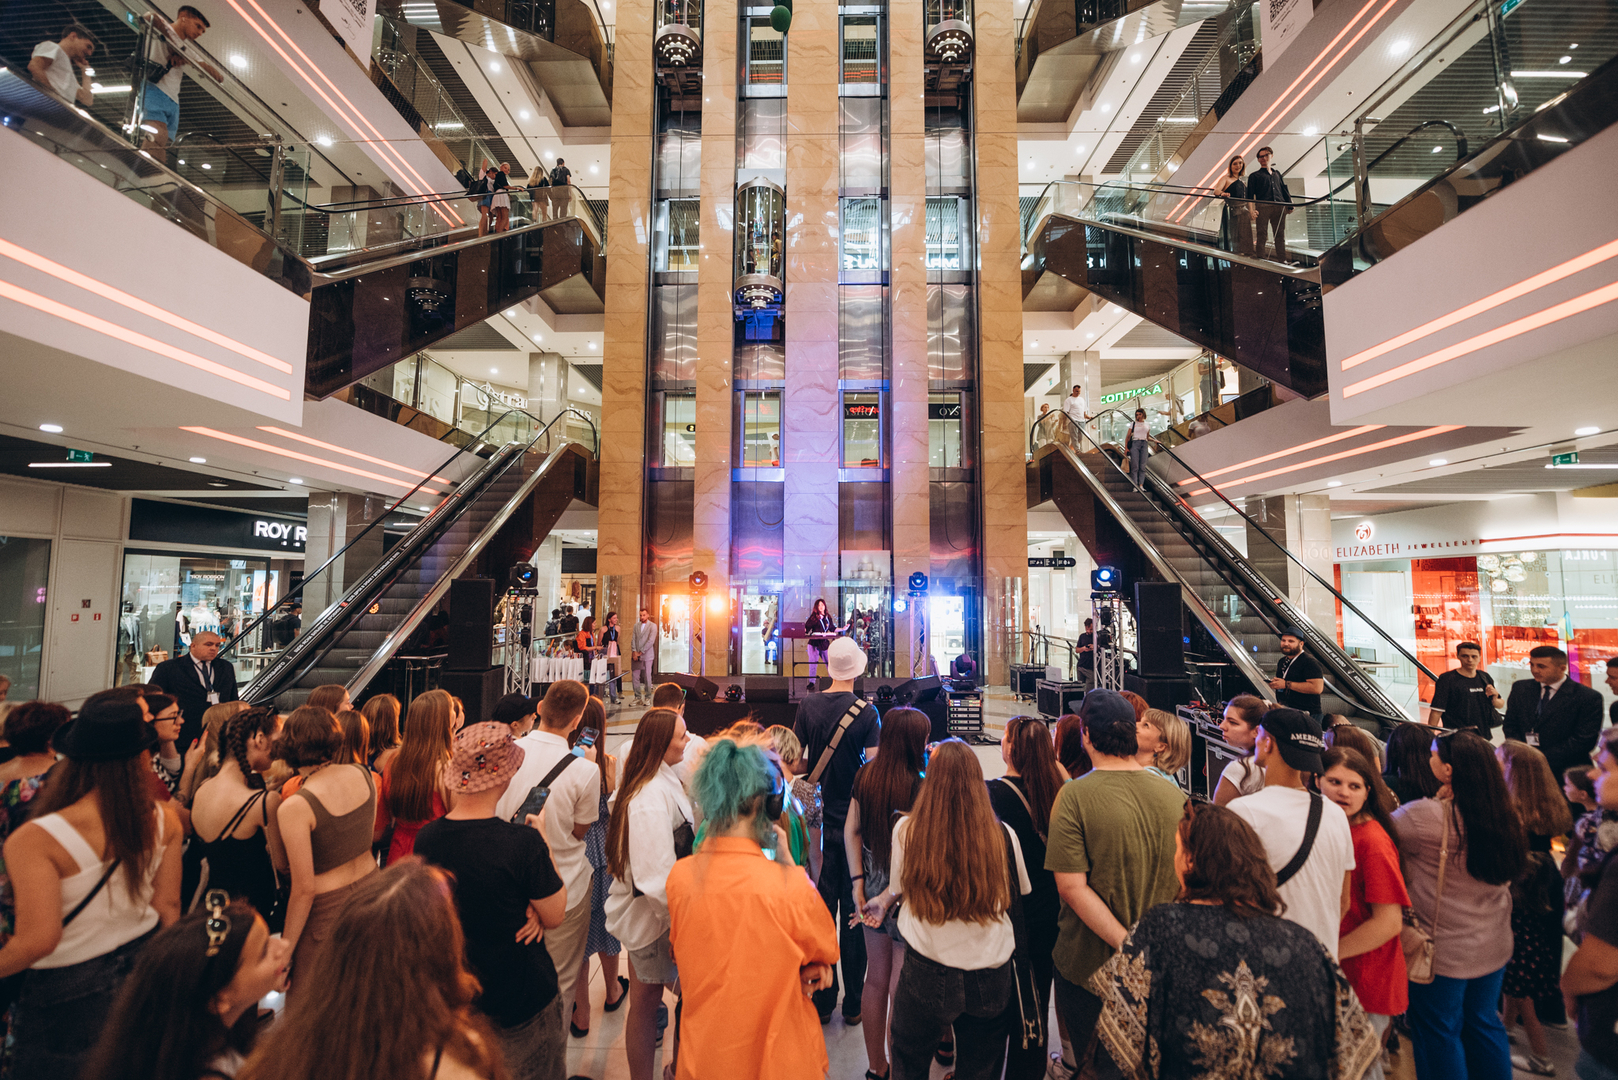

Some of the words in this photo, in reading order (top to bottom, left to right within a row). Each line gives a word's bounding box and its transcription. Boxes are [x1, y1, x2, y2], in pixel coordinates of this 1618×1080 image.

[1100, 384, 1162, 405] СОПТИКА
[939, 407, 960, 416] OYS
[254, 520, 292, 540] ROY
[1336, 543, 1399, 558] ELIZABETH
[1407, 539, 1476, 550] JEWELLERY
[1593, 574, 1618, 585] ELI
